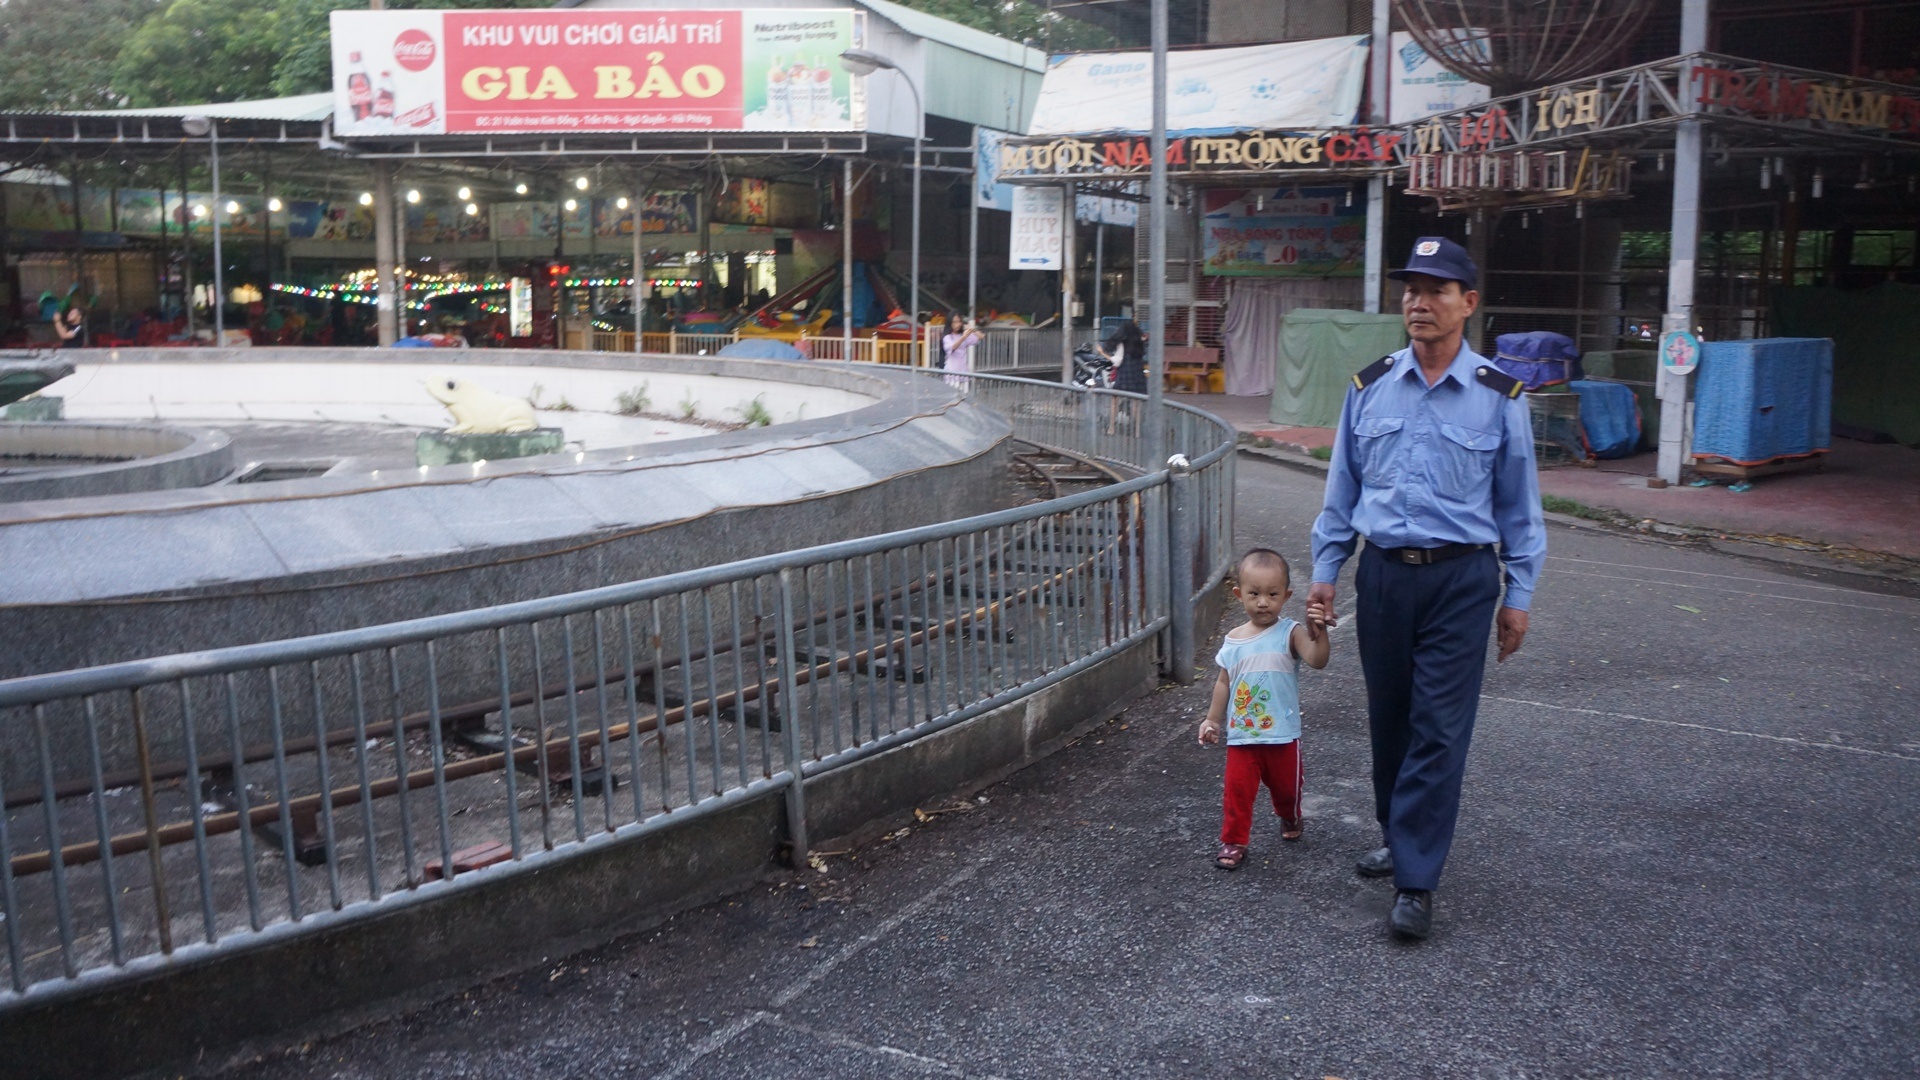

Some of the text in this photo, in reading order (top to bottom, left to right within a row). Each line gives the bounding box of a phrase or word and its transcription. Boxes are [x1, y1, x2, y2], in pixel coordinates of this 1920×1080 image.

[463, 16, 724, 46] KHU VUI CHƠI GIẢI TRÍ
[461, 51, 726, 101] GIA BẢO
[1325, 127, 1402, 162] CÂY
[1536, 86, 1600, 132] ÍCH
[1017, 217, 1057, 233] HUY
